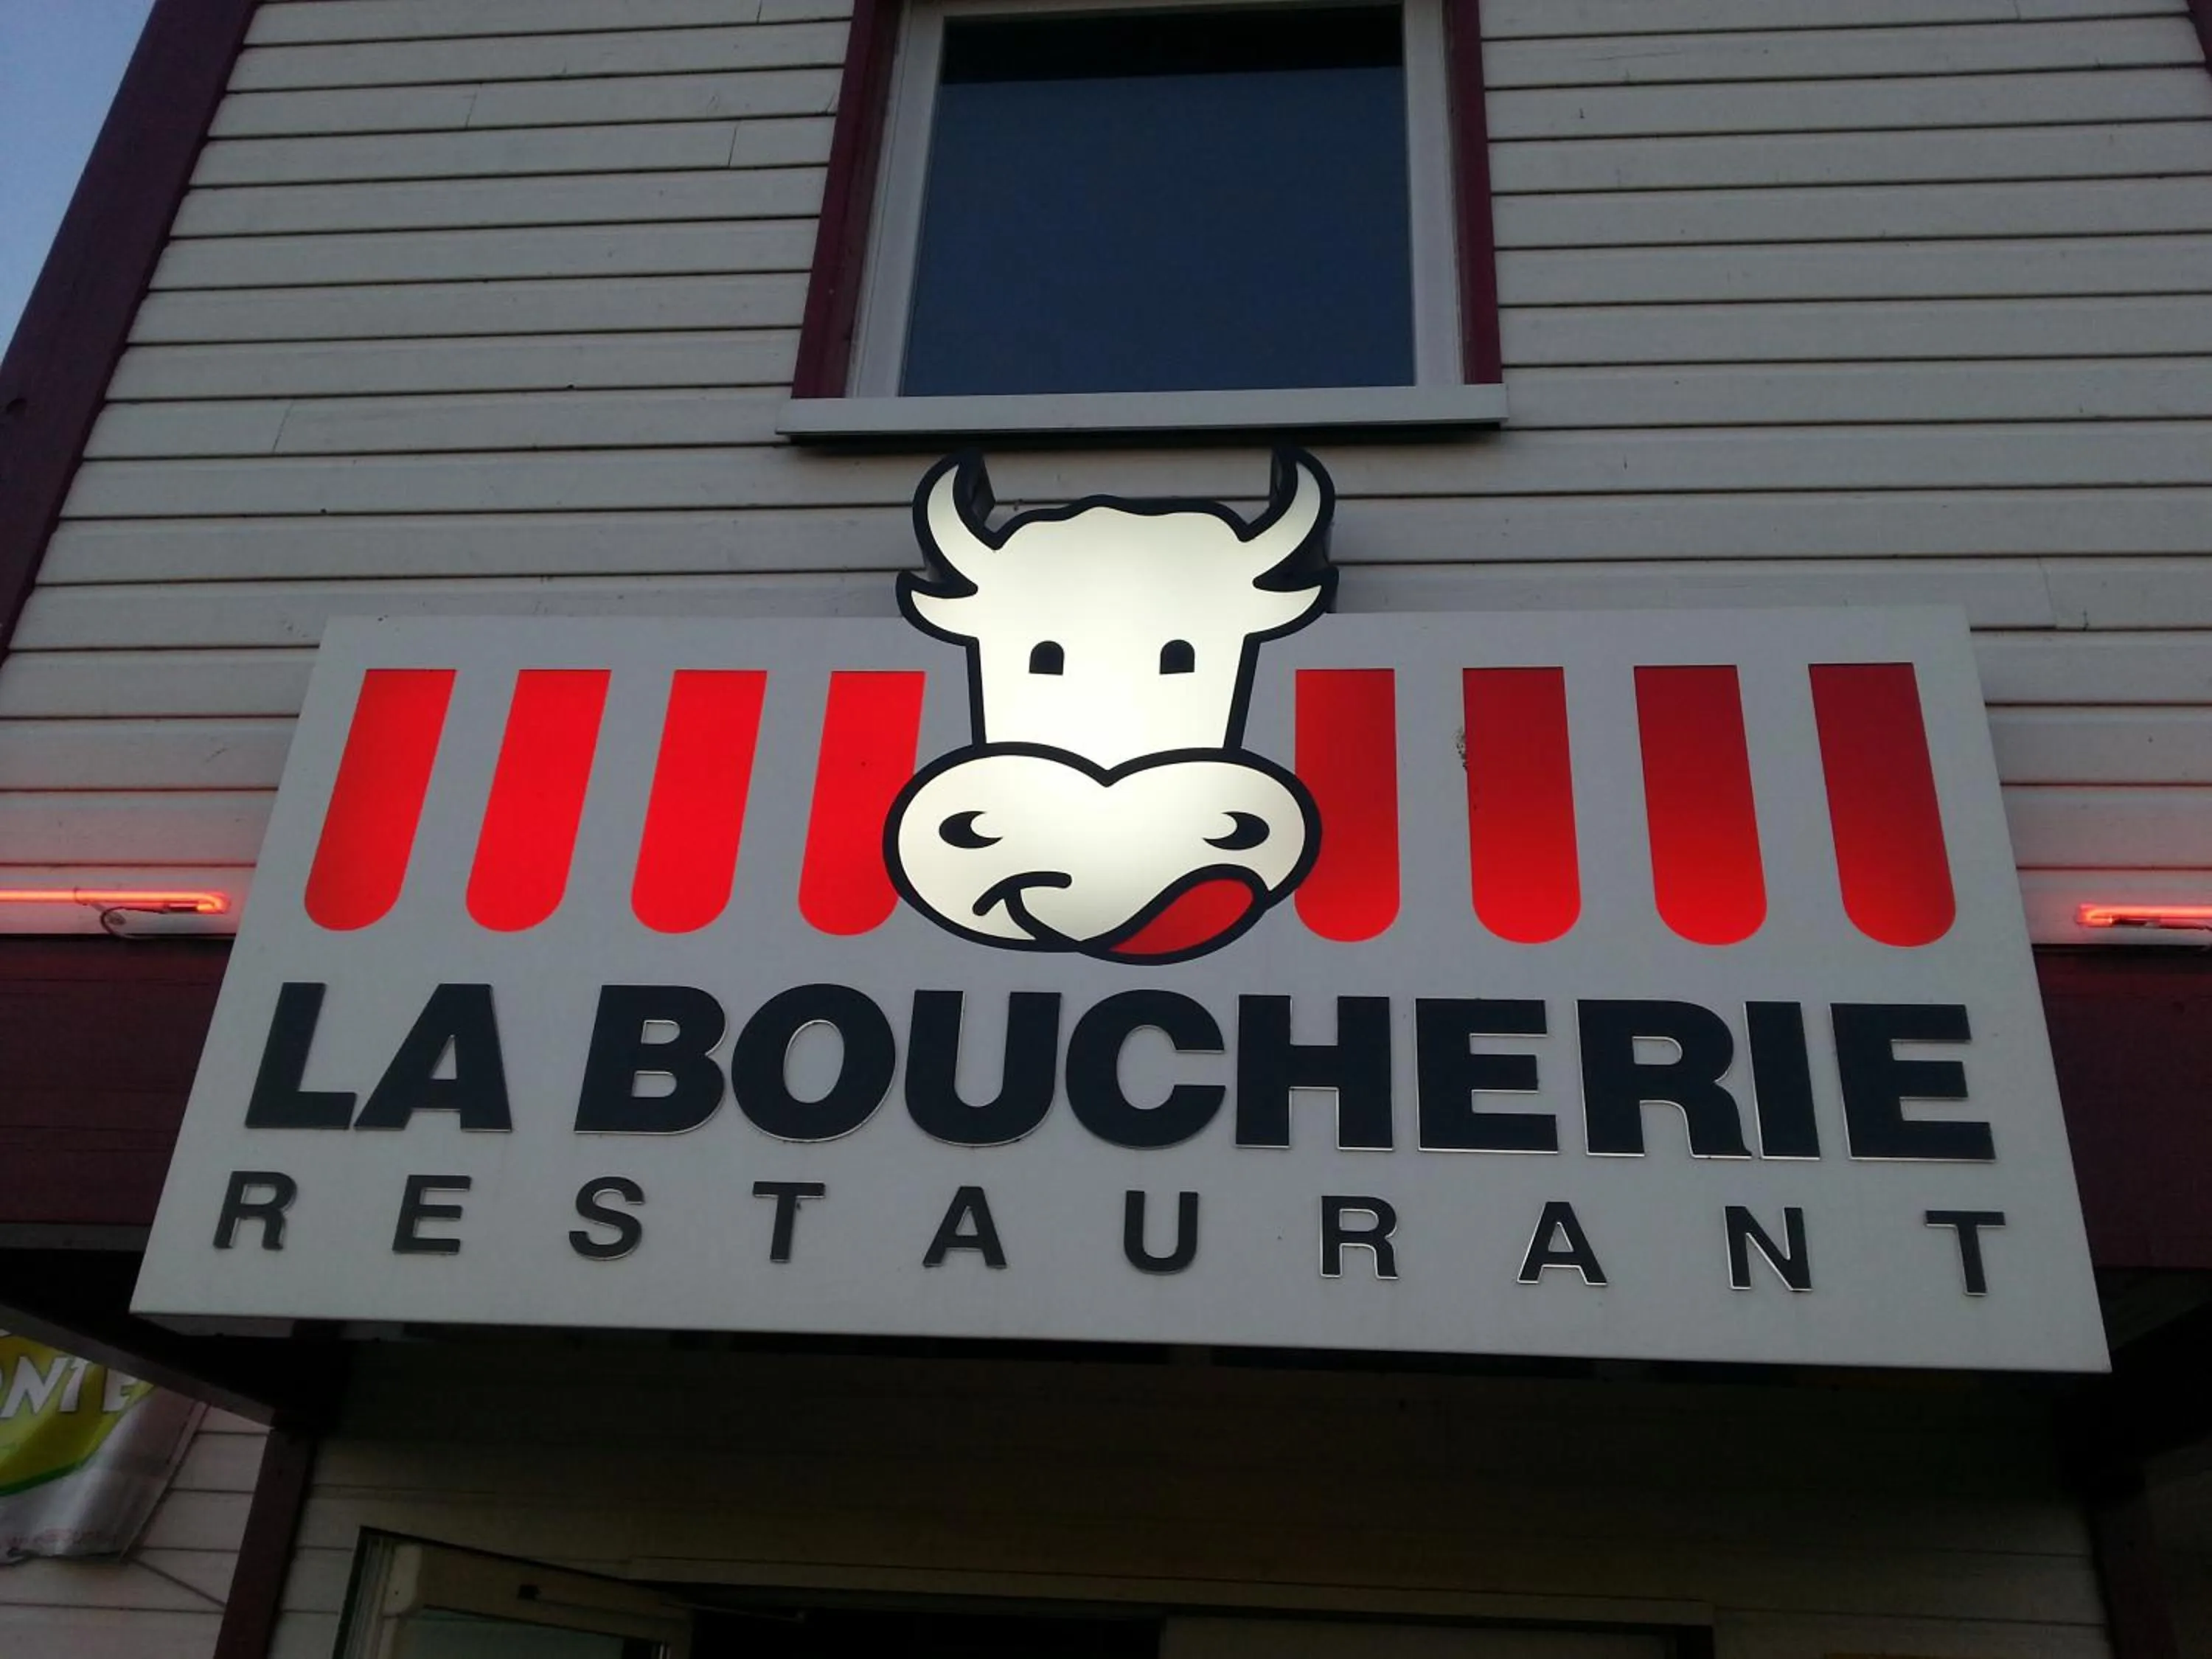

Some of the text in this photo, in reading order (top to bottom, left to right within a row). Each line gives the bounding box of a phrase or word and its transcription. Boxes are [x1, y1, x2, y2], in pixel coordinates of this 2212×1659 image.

[244, 981, 1997, 1161] LA BOUCHERIE
[212, 1170, 2006, 1295] RESTAURANT
[0, 1354, 139, 1418] NTE
